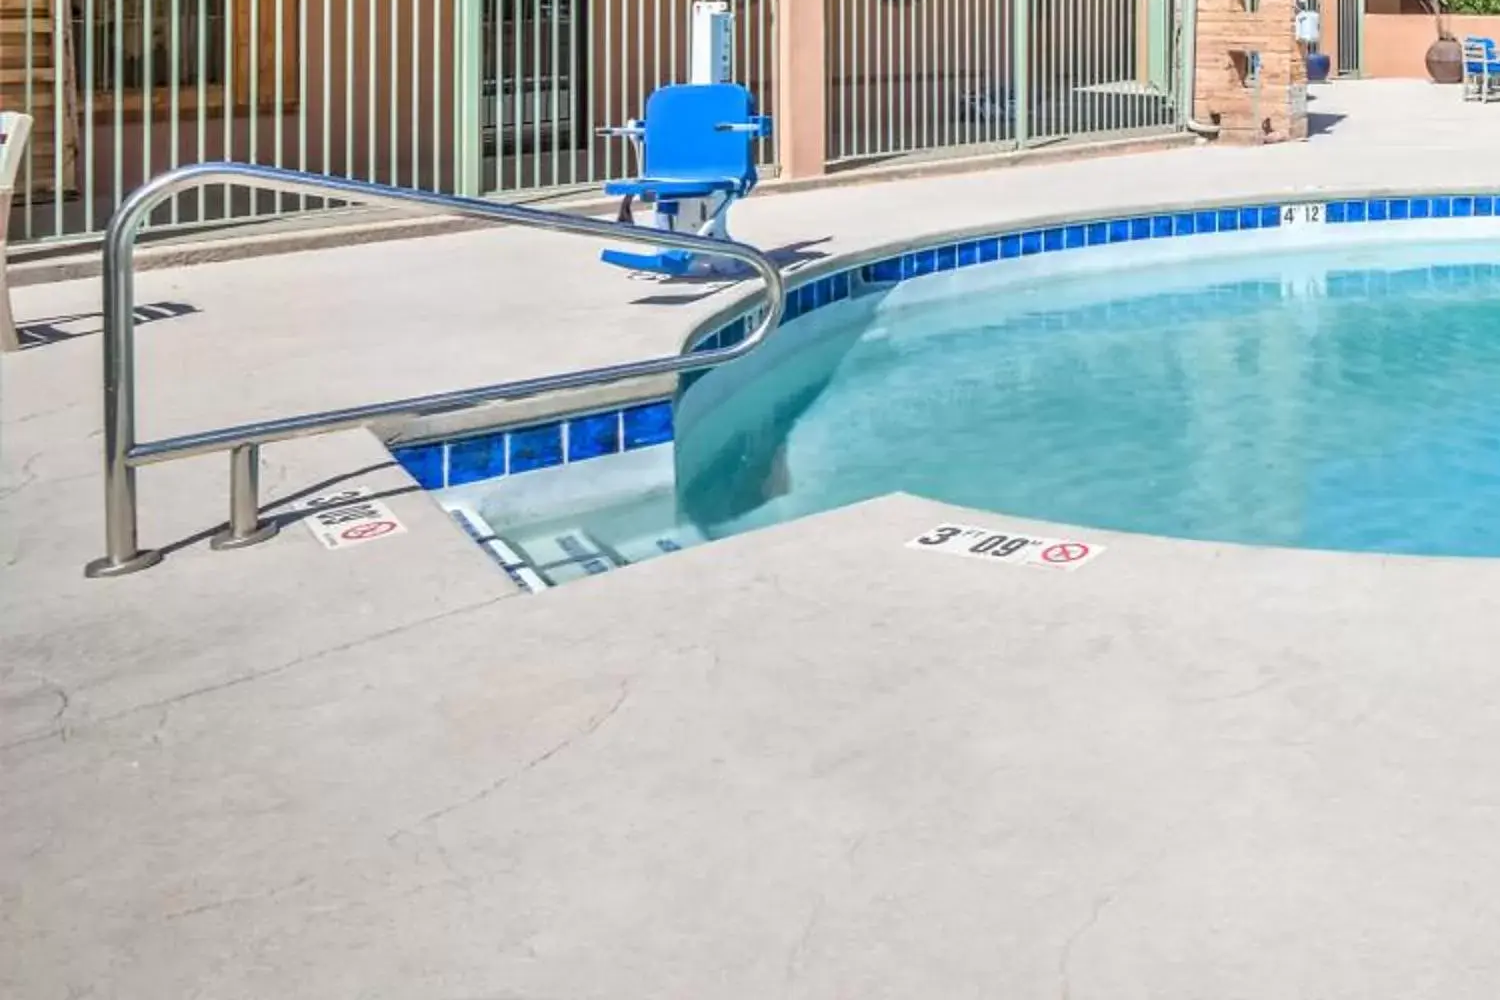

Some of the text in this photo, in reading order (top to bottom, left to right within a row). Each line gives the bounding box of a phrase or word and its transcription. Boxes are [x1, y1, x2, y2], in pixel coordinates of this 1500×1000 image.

[1284, 207, 1294, 224] 4
[1305, 206, 1319, 222] 12
[917, 526, 962, 546] 3
[968, 534, 1030, 557] 09
